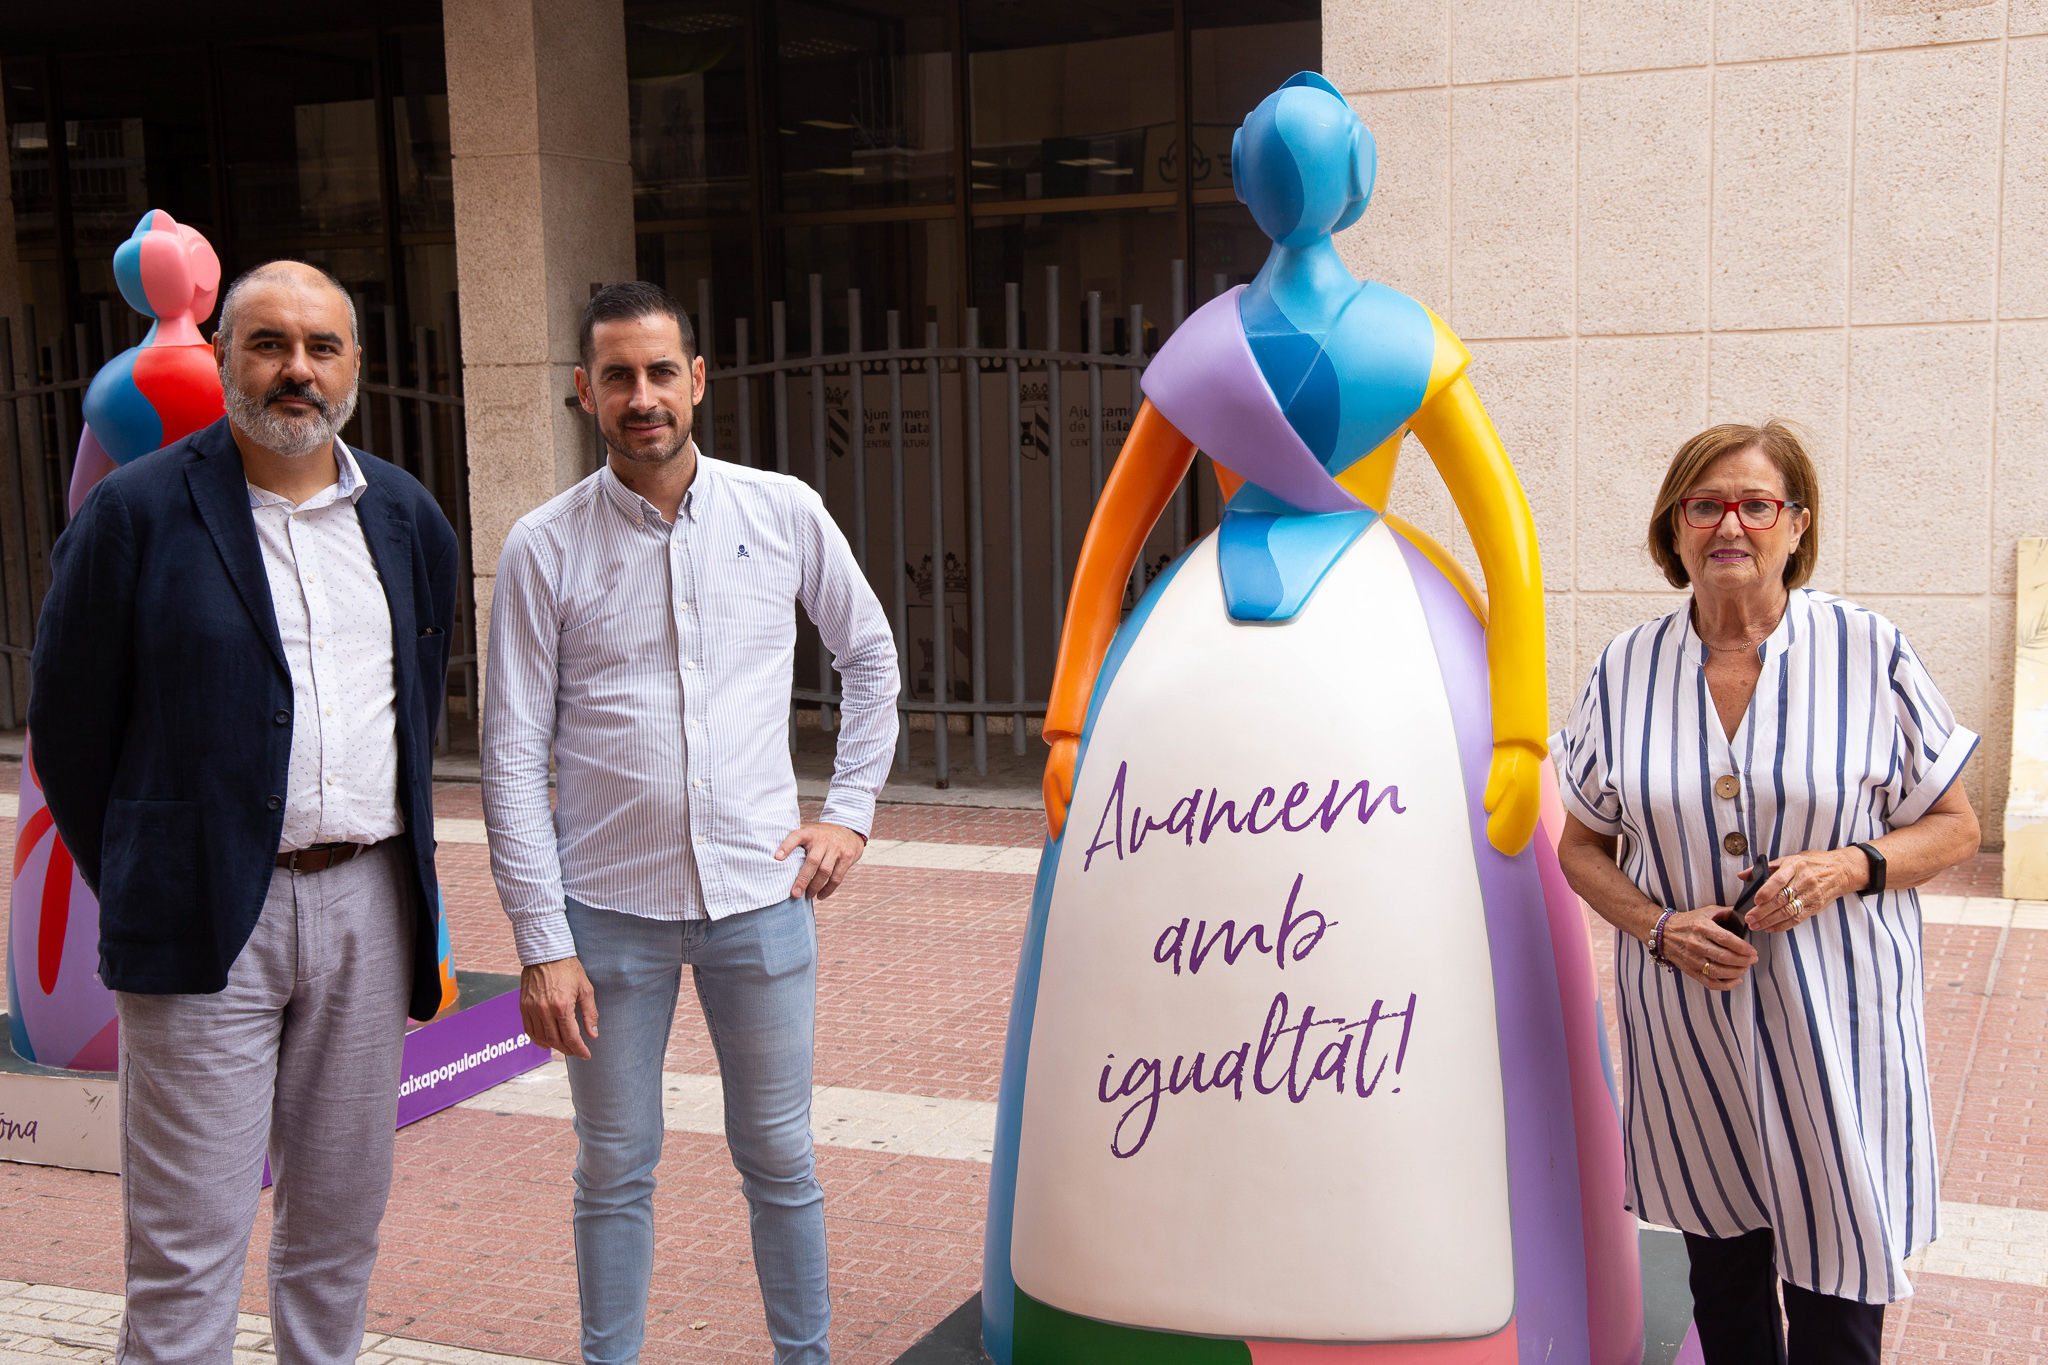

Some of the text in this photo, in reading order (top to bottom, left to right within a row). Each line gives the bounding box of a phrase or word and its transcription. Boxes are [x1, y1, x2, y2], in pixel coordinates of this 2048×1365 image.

[1069, 420, 1086, 433] de
[1083, 760, 1407, 872] Avancem
[1153, 872, 1339, 976] amb
[1097, 991, 1417, 1159] igualtat!
